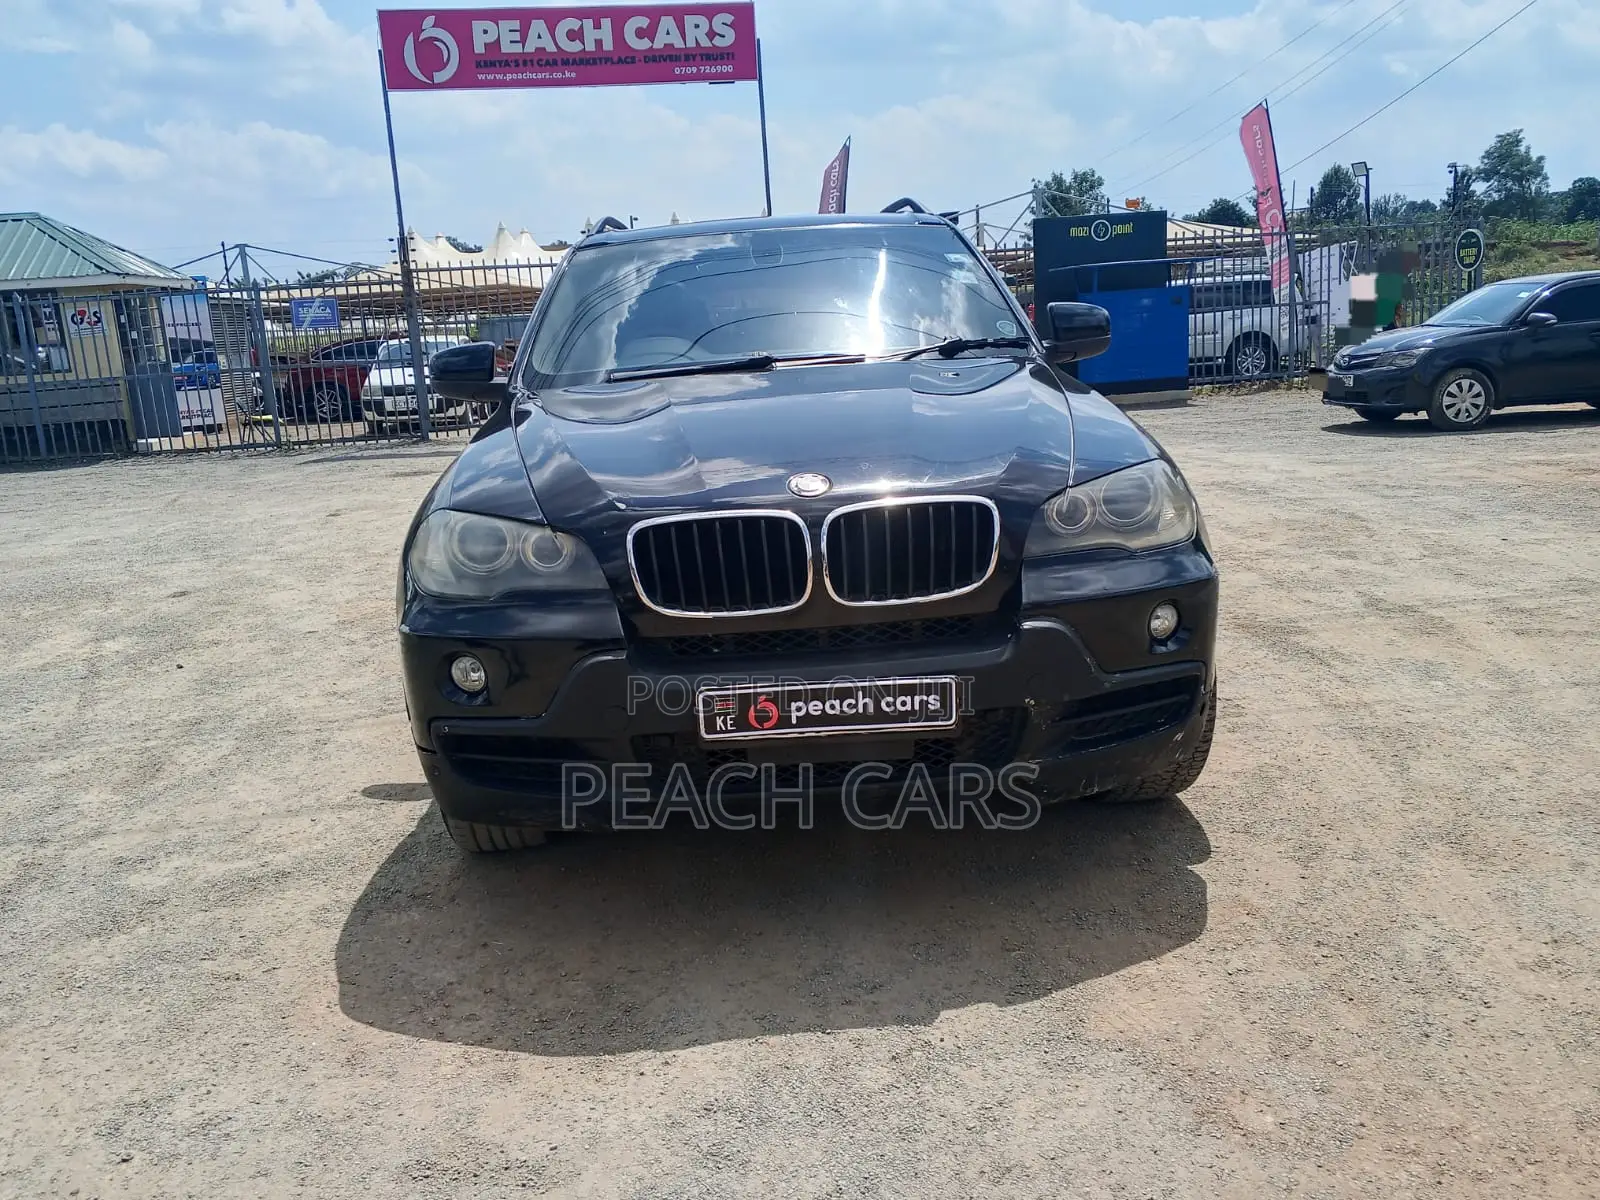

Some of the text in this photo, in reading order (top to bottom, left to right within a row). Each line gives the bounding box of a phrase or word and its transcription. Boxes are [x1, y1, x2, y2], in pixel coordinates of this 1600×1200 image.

[472, 12, 736, 54] PEACH CARS
[475, 59, 519, 69] KENYA'S
[536, 57, 558, 68] CAR
[560, 56, 636, 67] MARKETPLACE
[643, 54, 682, 64] DRIVEN
[684, 53, 697, 63] BY
[698, 51, 735, 62] TRUST!
[476, 70, 577, 81] www.peachcars.co.ke
[674, 64, 734, 75] 0709 726900
[1112, 221, 1134, 238] point
[716, 690, 940, 732] KE peach cars
